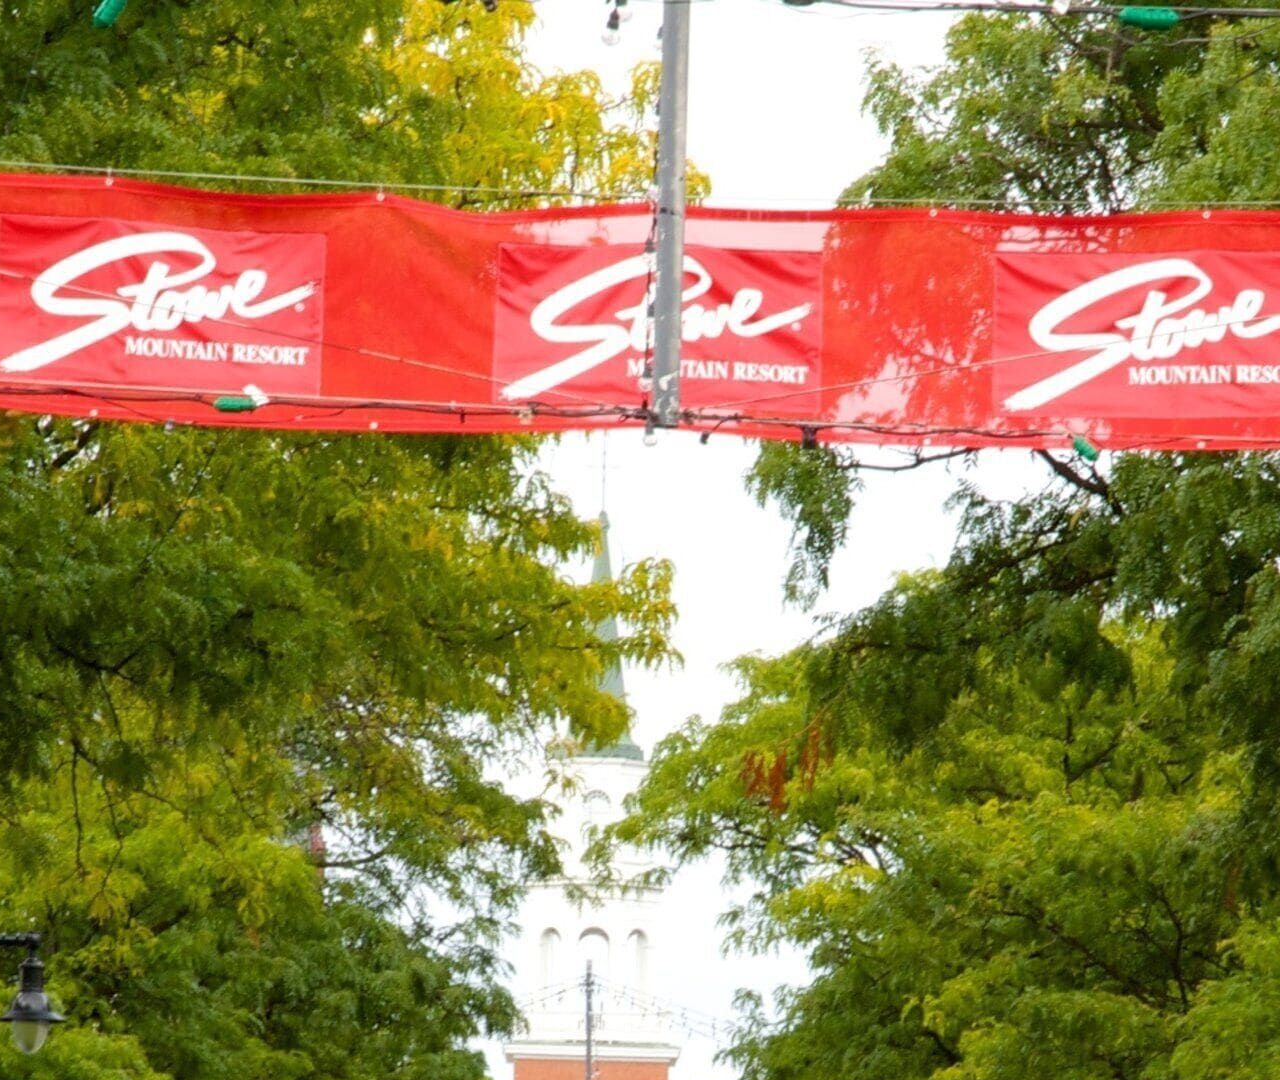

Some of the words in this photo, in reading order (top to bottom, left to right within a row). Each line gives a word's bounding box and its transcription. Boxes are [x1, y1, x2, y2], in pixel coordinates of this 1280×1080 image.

[502, 251, 813, 399] Stwe
[124, 335, 229, 363] MOUNTAIN
[231, 342, 309, 366] RESORT
[627, 357, 729, 381] MTAIN
[732, 363, 810, 385] RESORT
[1128, 364, 1233, 385] MOUNTAIN
